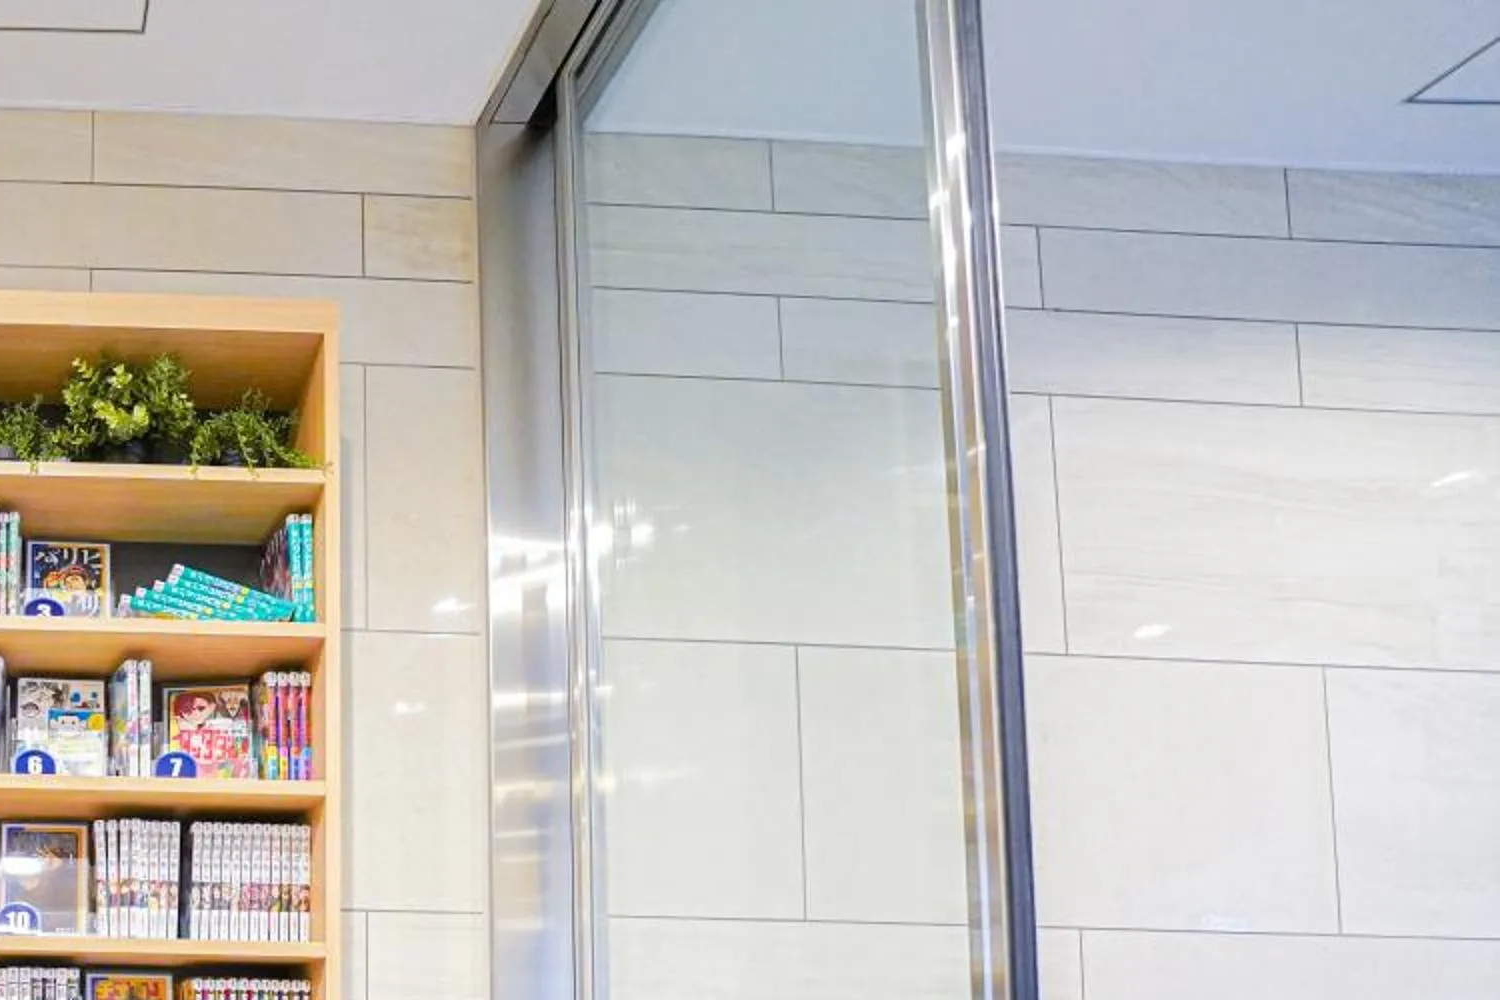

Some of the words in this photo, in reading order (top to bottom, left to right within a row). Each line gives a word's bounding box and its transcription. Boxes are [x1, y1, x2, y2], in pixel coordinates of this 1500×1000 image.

[28, 755, 43, 774] 6
[170, 758, 183, 776] 7
[8, 911, 30, 929] 10
